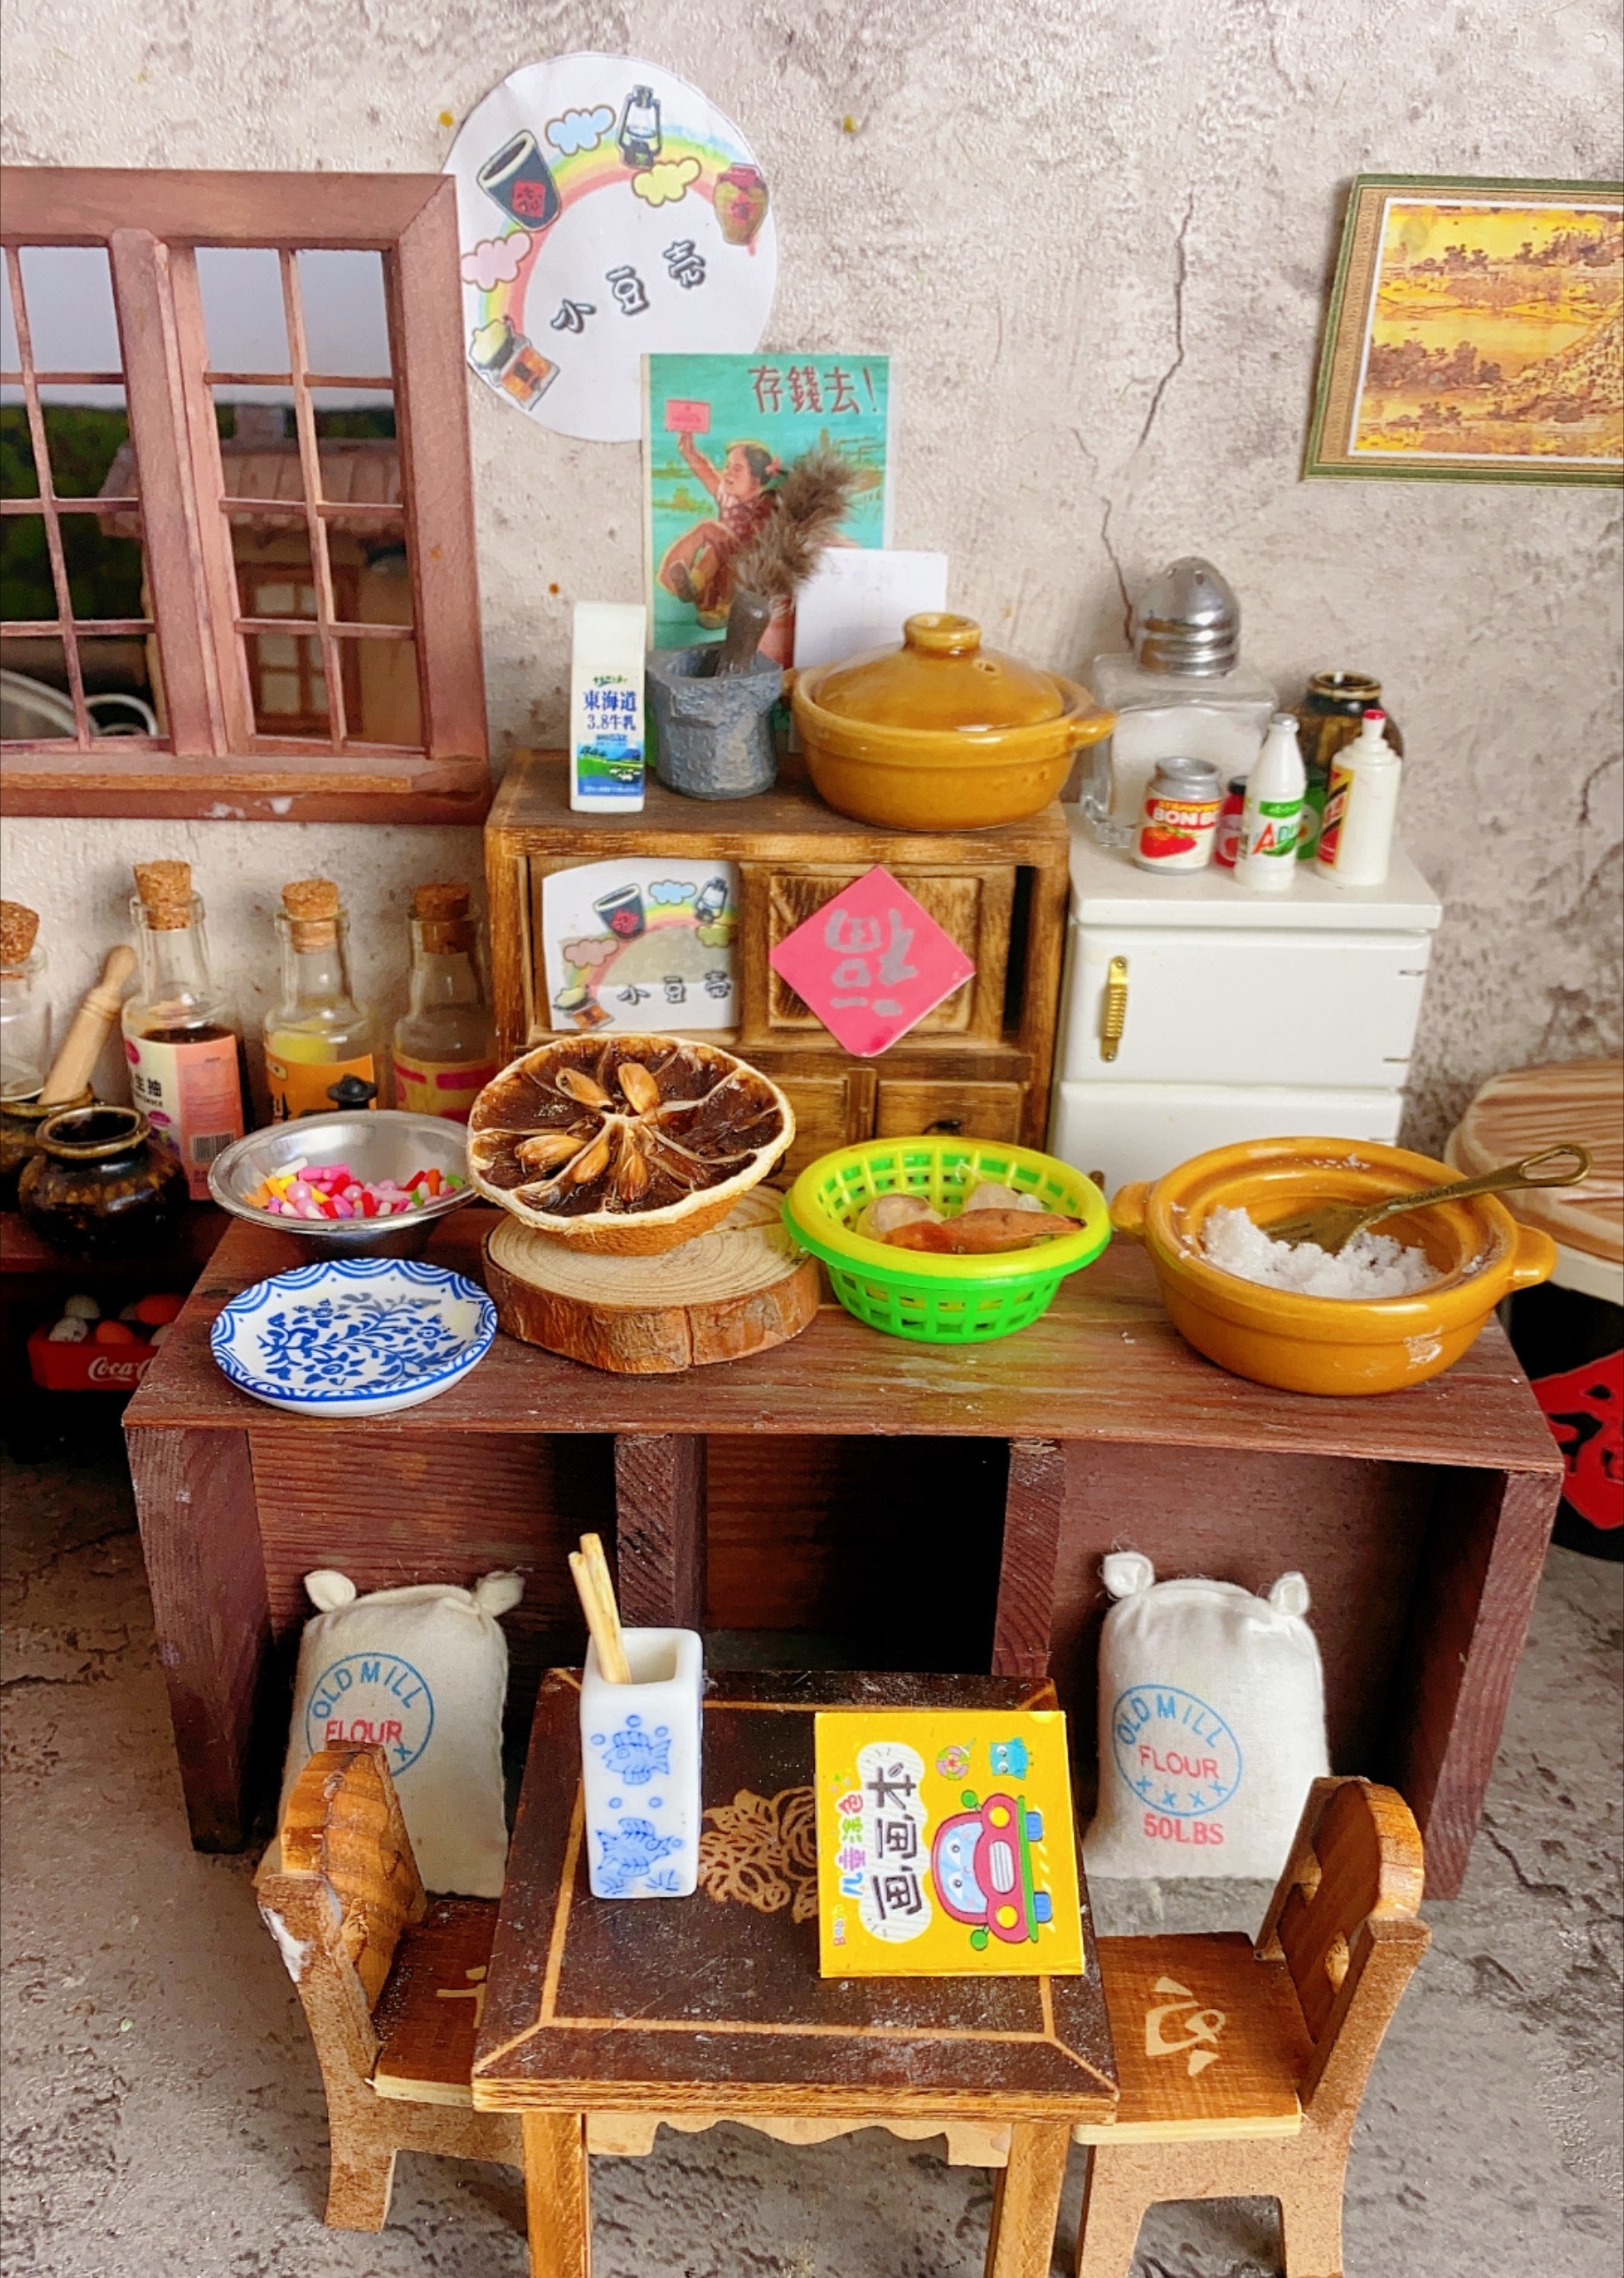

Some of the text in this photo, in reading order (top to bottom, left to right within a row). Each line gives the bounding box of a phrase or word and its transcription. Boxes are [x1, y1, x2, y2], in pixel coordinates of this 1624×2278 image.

[747, 364, 877, 415] 存錢去!
[88, 1356, 152, 1382] Coca-C
[312, 1661, 422, 1719] OLD MILL
[326, 1719, 402, 1744] FLOUR
[1117, 1693, 1224, 1748] OLD MILL
[1138, 1745, 1221, 1780] FLOUR
[839, 1794, 866, 1895] 儿童涂色
[866, 1762, 923, 1921] 画画本
[1143, 1813, 1225, 1845] 50LBS
